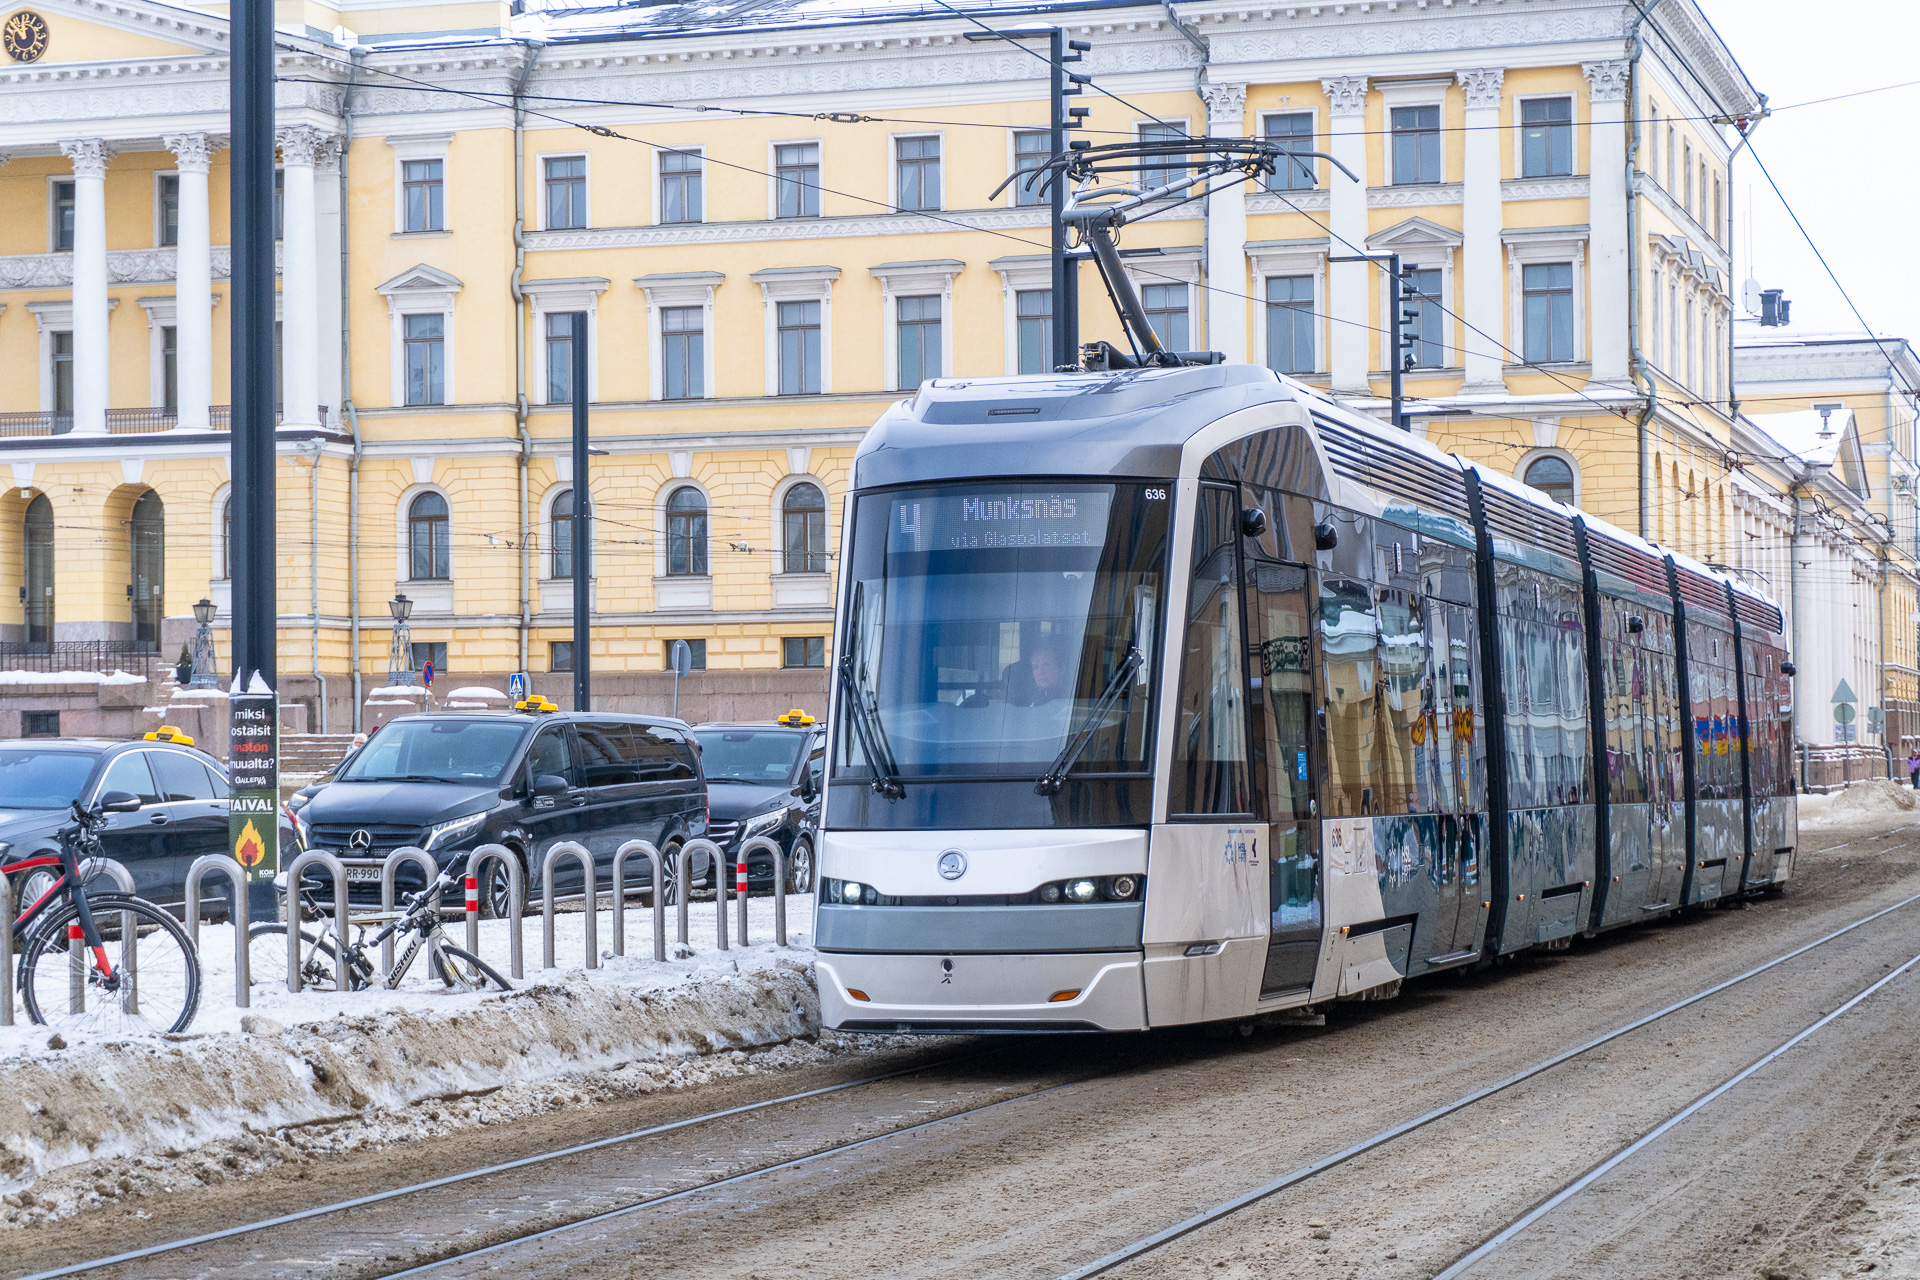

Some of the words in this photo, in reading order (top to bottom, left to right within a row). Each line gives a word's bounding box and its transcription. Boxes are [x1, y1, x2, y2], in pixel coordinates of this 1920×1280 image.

[14, 50, 21, 58] 7
[22, 51, 29, 60] 6
[1144, 488, 1166, 500] 636
[963, 495, 1077, 521] Munksnäs
[900, 503, 921, 552] 4
[951, 533, 978, 548] via
[984, 530, 1092, 547] Glaspalatset
[234, 708, 266, 720] miksi
[231, 724, 271, 736] ostaisit
[232, 742, 269, 753] maton
[229, 758, 275, 769] muualta?
[229, 798, 274, 812] TAIVAL
[1332, 827, 1343, 848] 636
[387, 939, 417, 986] NISHIKI
